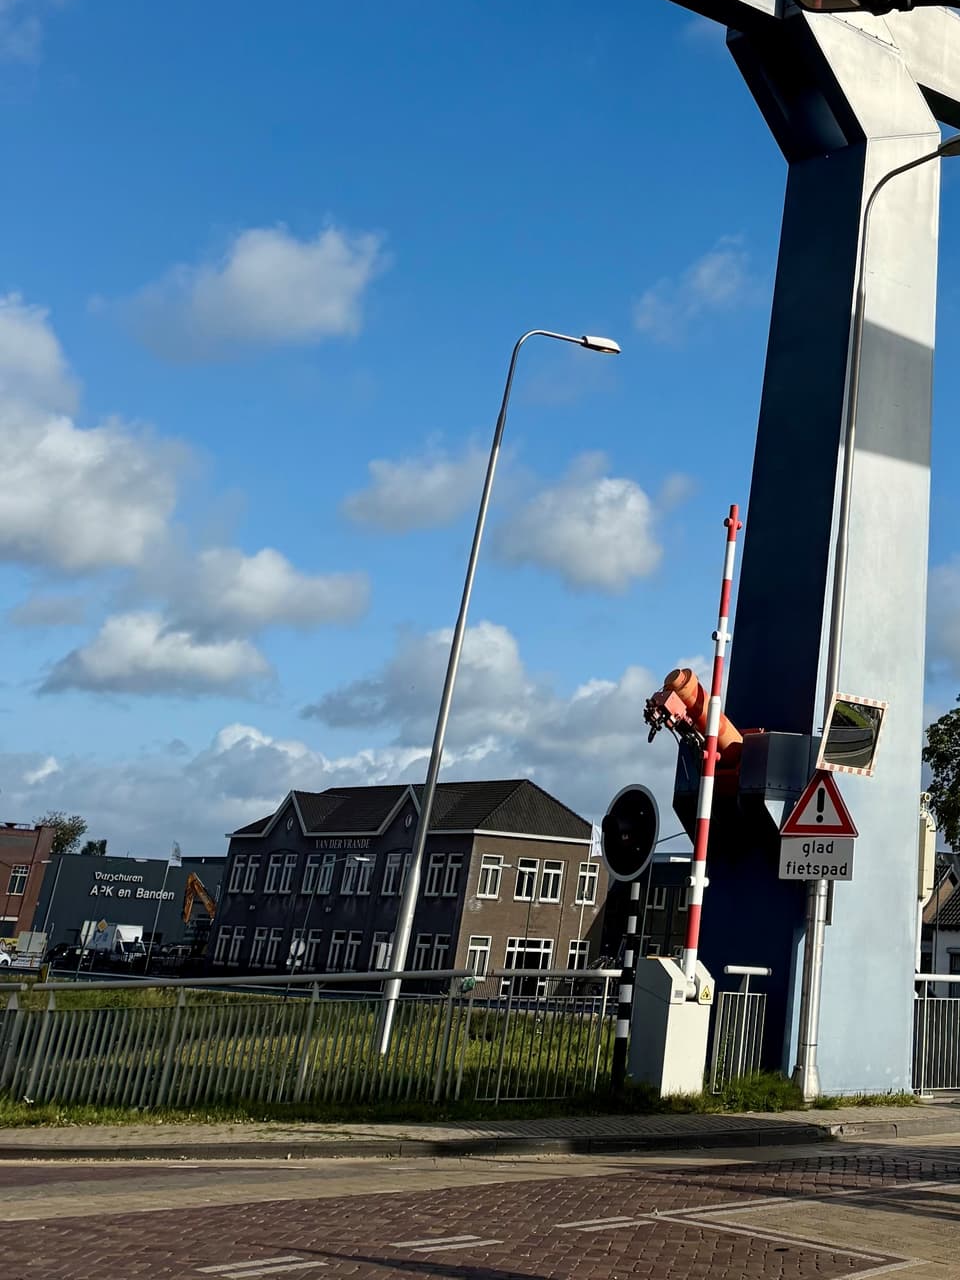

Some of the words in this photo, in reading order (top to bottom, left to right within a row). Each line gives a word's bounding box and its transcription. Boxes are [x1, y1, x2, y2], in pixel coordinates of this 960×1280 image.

[802, 840, 834, 857] glad
[786, 861, 848, 878] fietspad
[118, 887, 131, 898] en
[136, 887, 175, 900] Banden
